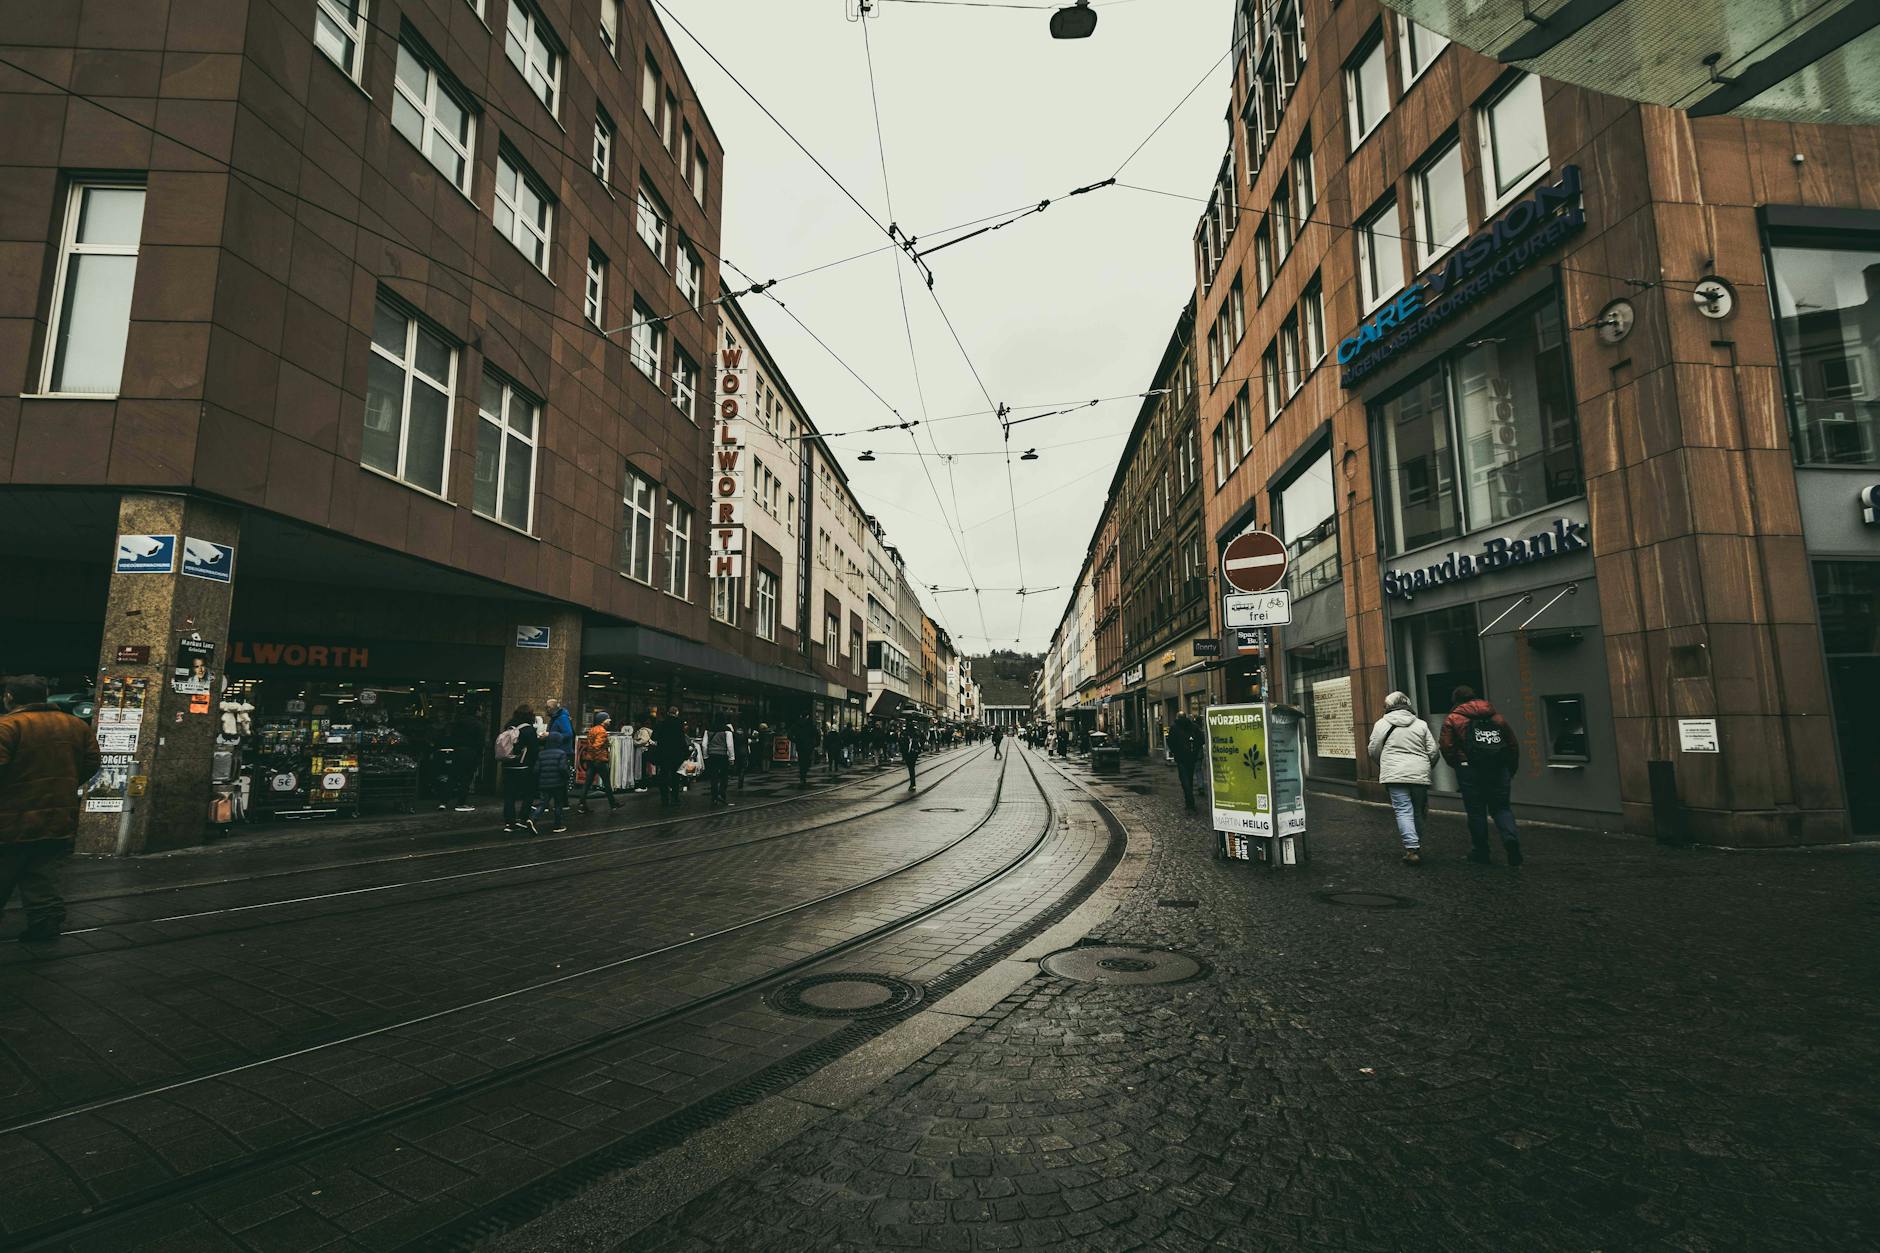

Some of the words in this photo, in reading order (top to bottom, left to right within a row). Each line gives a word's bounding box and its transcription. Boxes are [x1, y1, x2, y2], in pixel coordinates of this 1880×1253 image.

[1337, 283, 1425, 366] CARE
[1424, 164, 1583, 293] VISION
[1340, 207, 1587, 389] AUGENLASERKORREKTUREN
[716, 349, 742, 577] WOOLWORTH
[1384, 518, 1590, 600] Sparda-Bank
[1249, 610, 1269, 621] frei
[1247, 637, 1268, 645] Bak
[1208, 714, 1262, 726] WÜRZBURG
[327, 777, 341, 786] 2€
[1242, 819, 1270, 830] HEILIG
[1288, 818, 1305, 828] HEILIG
